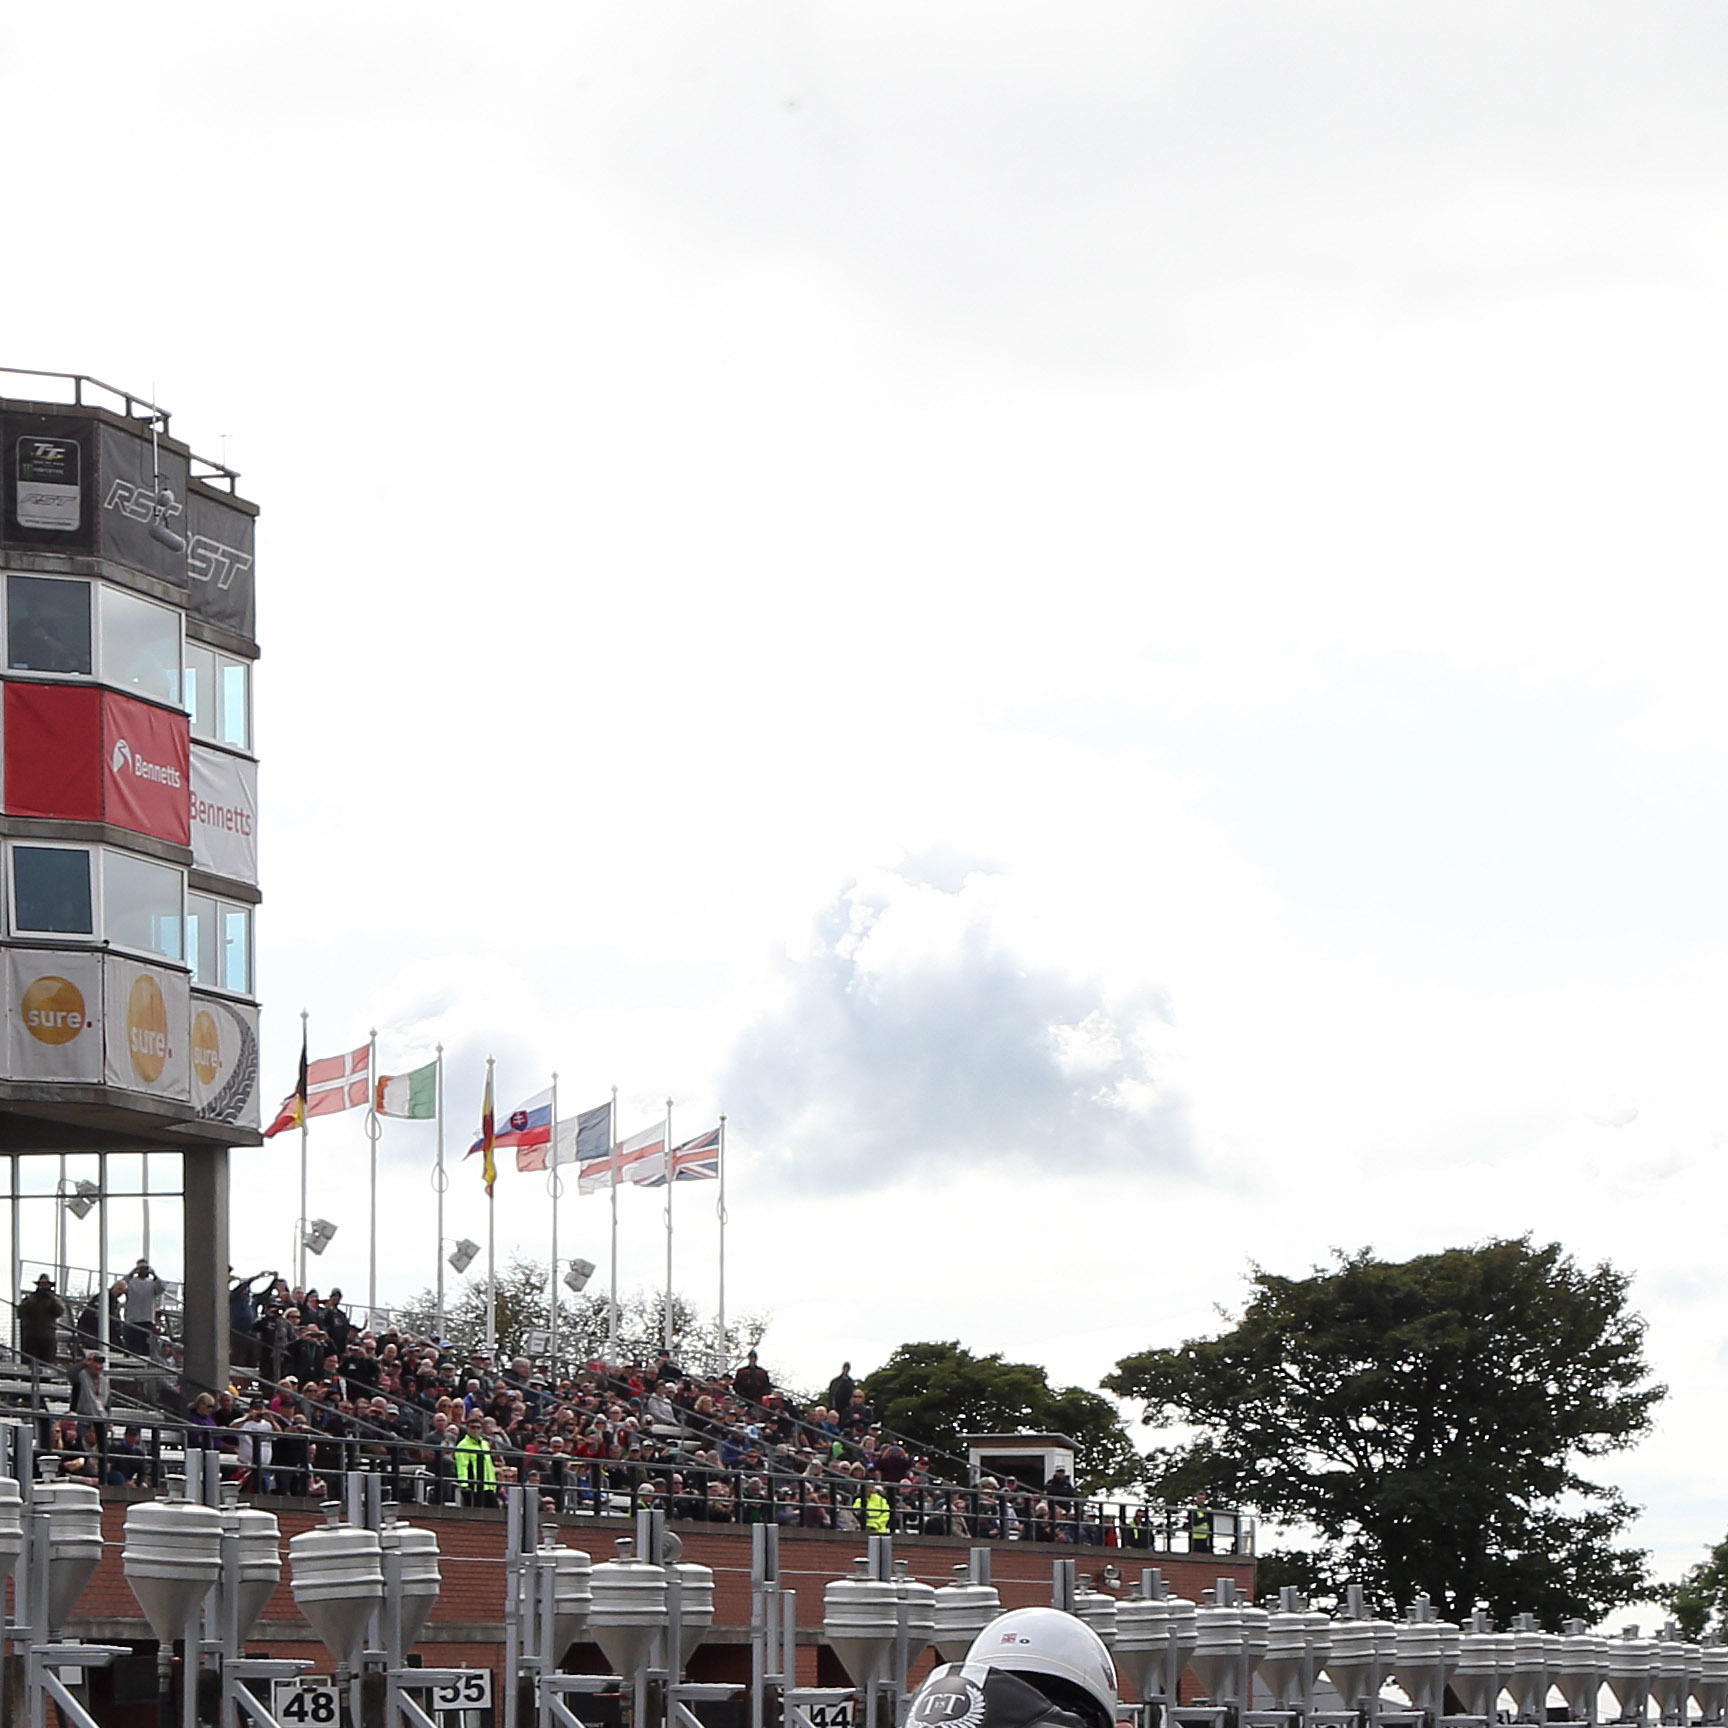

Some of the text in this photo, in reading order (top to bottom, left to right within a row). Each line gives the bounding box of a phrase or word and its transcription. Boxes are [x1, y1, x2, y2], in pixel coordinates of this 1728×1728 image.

[188, 530, 252, 591] ST
[134, 753, 181, 788] Bennetts
[190, 790, 252, 836] Bennetts
[282, 1692, 336, 1723] 48
